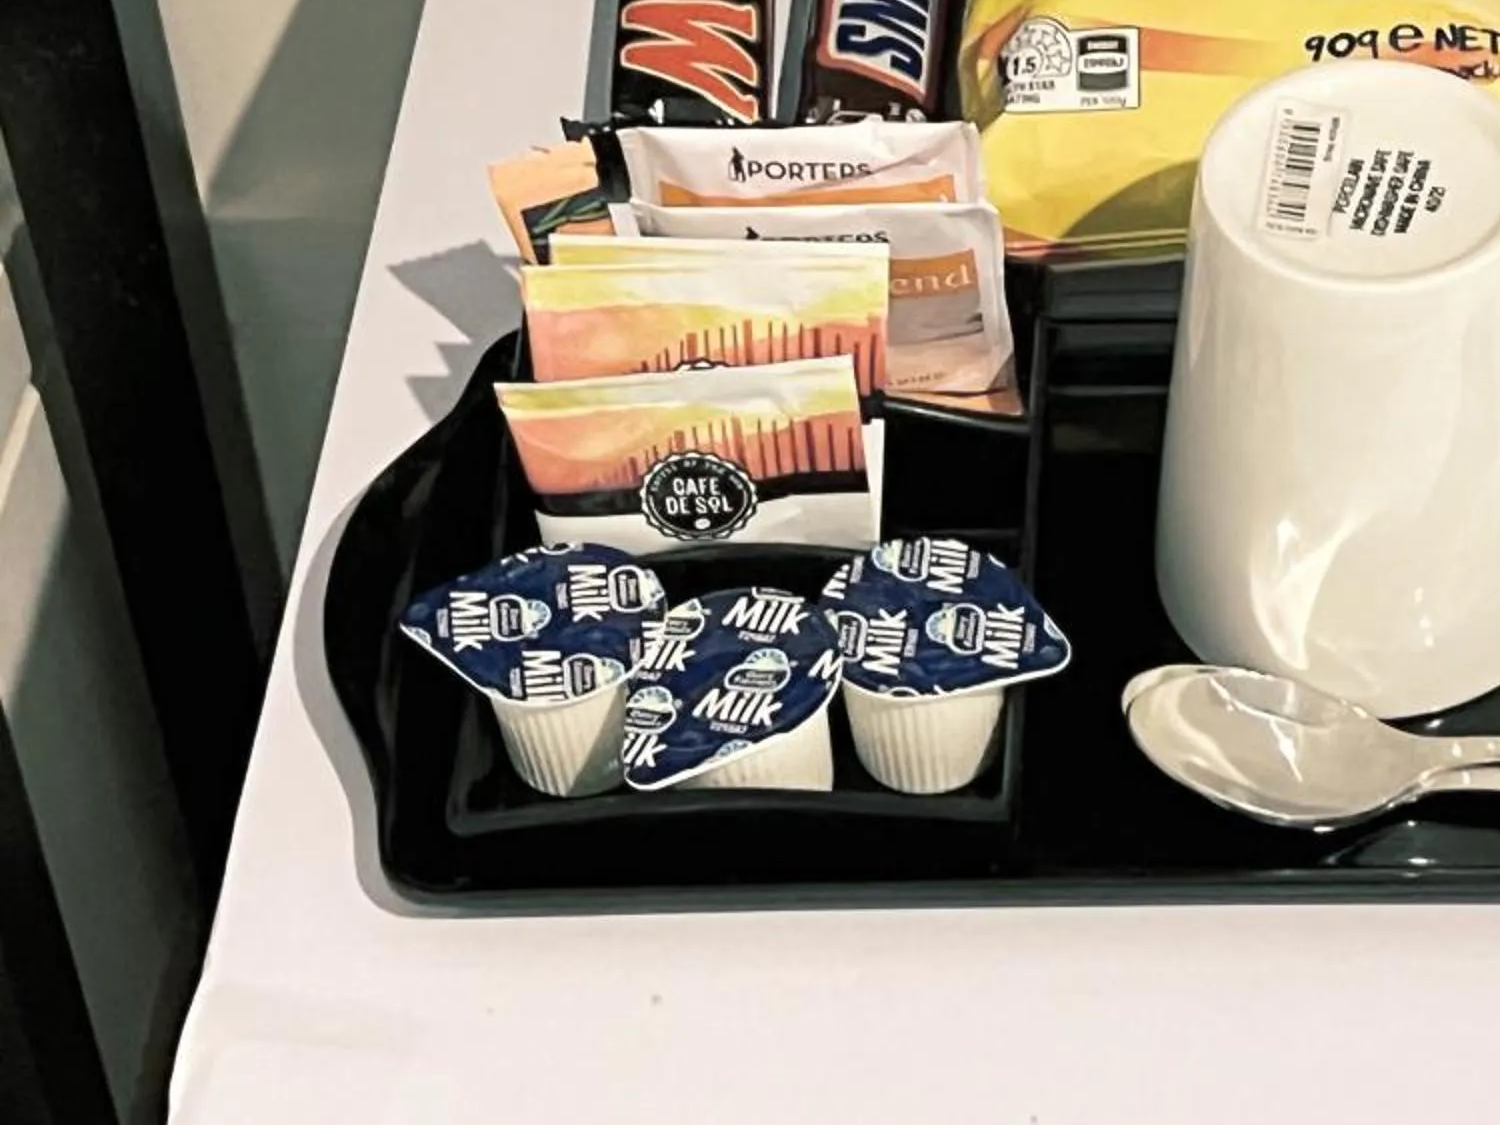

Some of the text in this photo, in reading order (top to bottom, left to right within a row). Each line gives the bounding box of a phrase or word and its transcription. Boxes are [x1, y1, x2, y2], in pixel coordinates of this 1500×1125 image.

[748, 160, 874, 182] PORTERS
[891, 263, 973, 294] end
[665, 495, 734, 515] DE SOL
[673, 477, 721, 496] CAFE
[567, 564, 611, 623] Milk
[449, 590, 492, 653] Milk
[721, 596, 811, 635] Milk
[861, 607, 908, 676] Milk
[981, 602, 1026, 669] Milk
[642, 638, 698, 672] ilk
[521, 650, 571, 702] Mil
[691, 688, 784, 726] Milk
[622, 732, 668, 768] ilk
